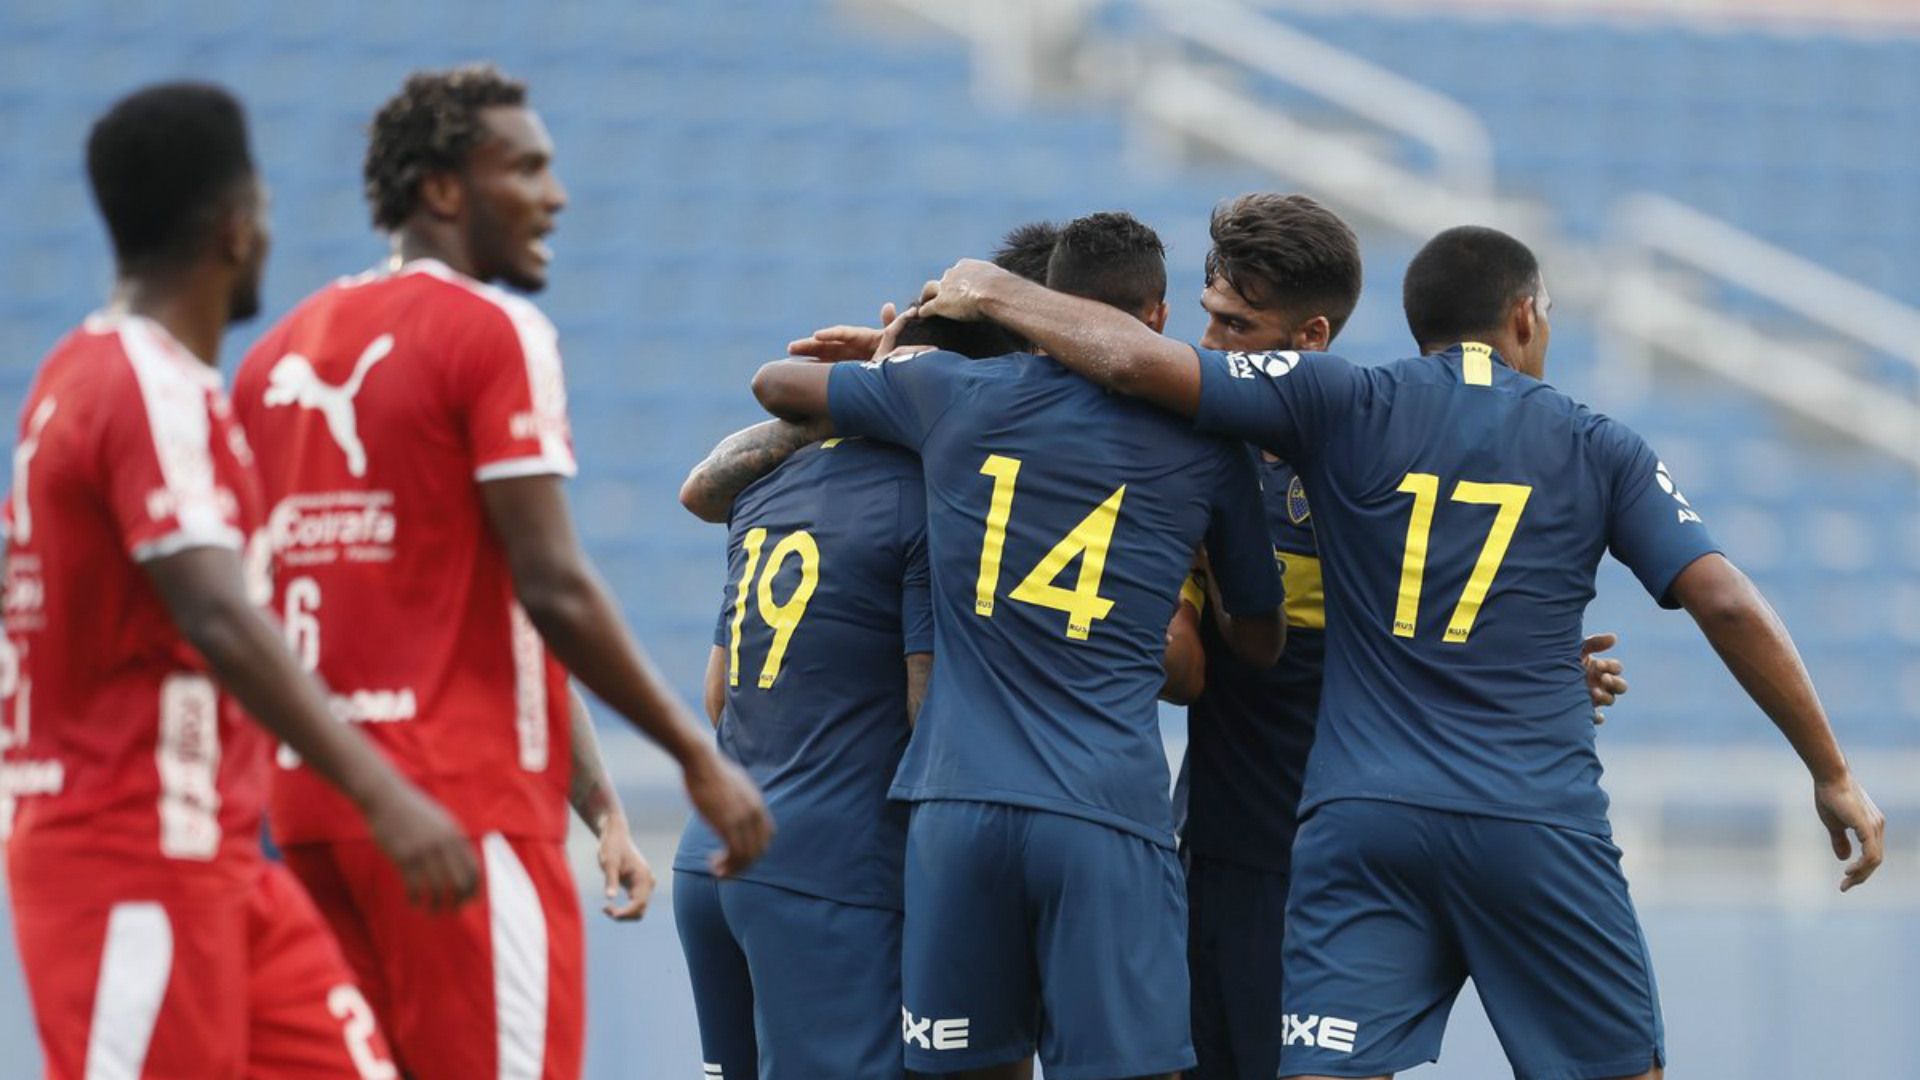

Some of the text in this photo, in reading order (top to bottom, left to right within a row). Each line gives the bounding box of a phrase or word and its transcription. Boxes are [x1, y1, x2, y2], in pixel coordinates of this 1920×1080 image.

[729, 527, 820, 689] 19
[975, 453, 1127, 640] 14
[1392, 472, 1533, 643] 17
[1394, 621, 1414, 632] RUS
